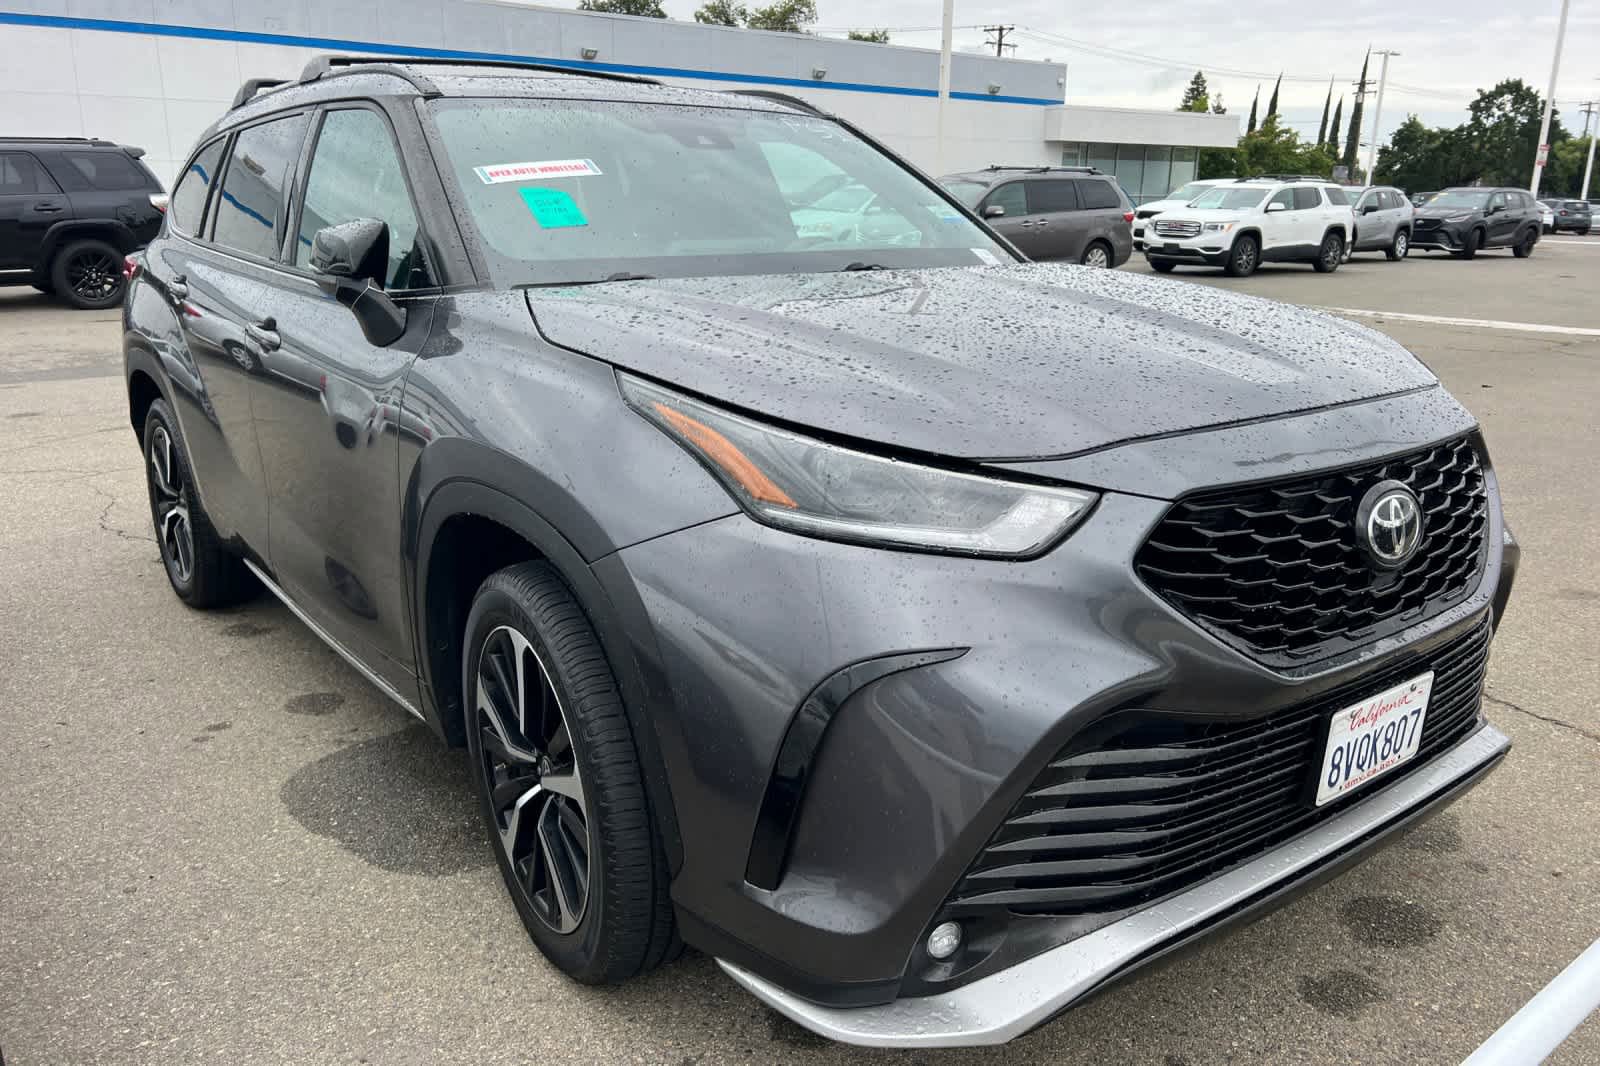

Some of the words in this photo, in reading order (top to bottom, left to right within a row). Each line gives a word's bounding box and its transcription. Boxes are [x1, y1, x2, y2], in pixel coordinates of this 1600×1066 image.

[513, 167, 538, 175] AUTO
[538, 164, 589, 173] WHOLESALE
[1350, 694, 1413, 732] California
[1328, 708, 1422, 788] 8VQK807
